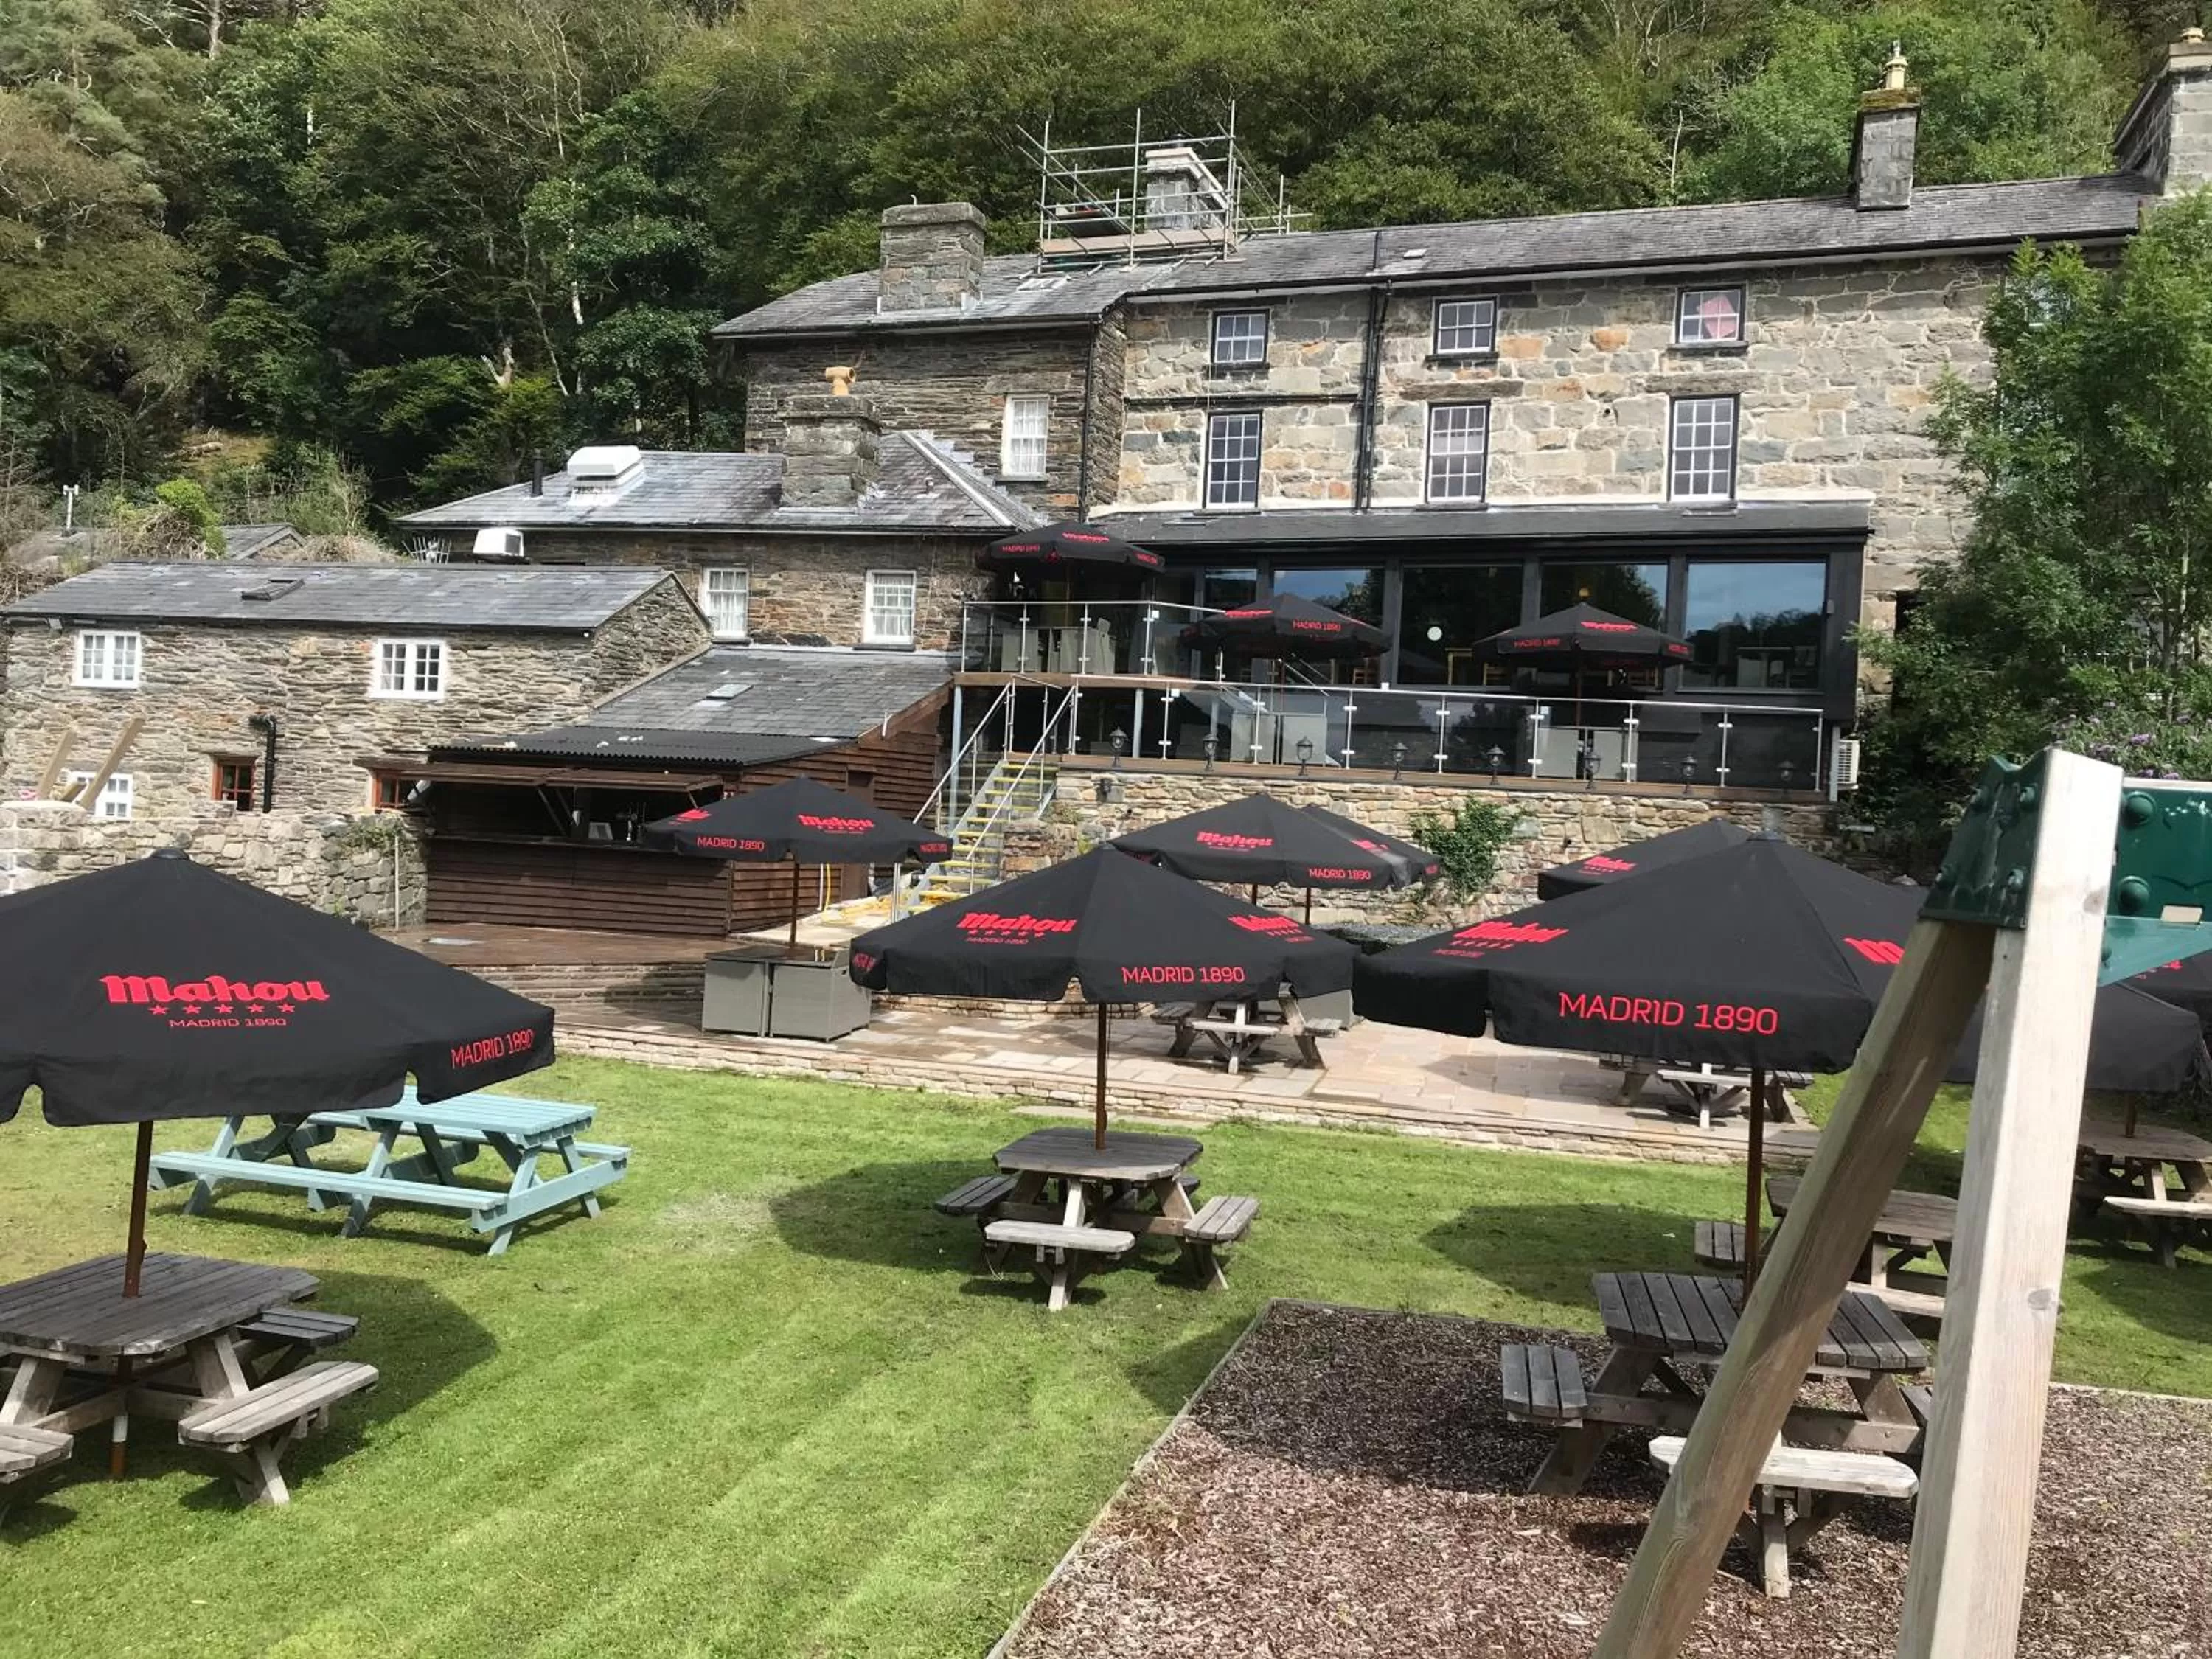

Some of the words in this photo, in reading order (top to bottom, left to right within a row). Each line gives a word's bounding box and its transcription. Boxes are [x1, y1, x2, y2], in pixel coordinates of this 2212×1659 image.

[697, 837, 737, 849] MADRID
[738, 840, 765, 852] 1890
[1309, 868, 1346, 879] MADRID
[1348, 869, 1371, 880] 1890
[1121, 967, 1194, 984] MADRID
[1199, 967, 1246, 983] 1890
[1559, 992, 1684, 1026] MADRID
[1694, 1004, 1778, 1035] 1890
[169, 1018, 240, 1027] MADRID
[245, 1018, 287, 1026] 1890
[451, 1036, 504, 1069] MADRID
[507, 1029, 534, 1054] 1890
